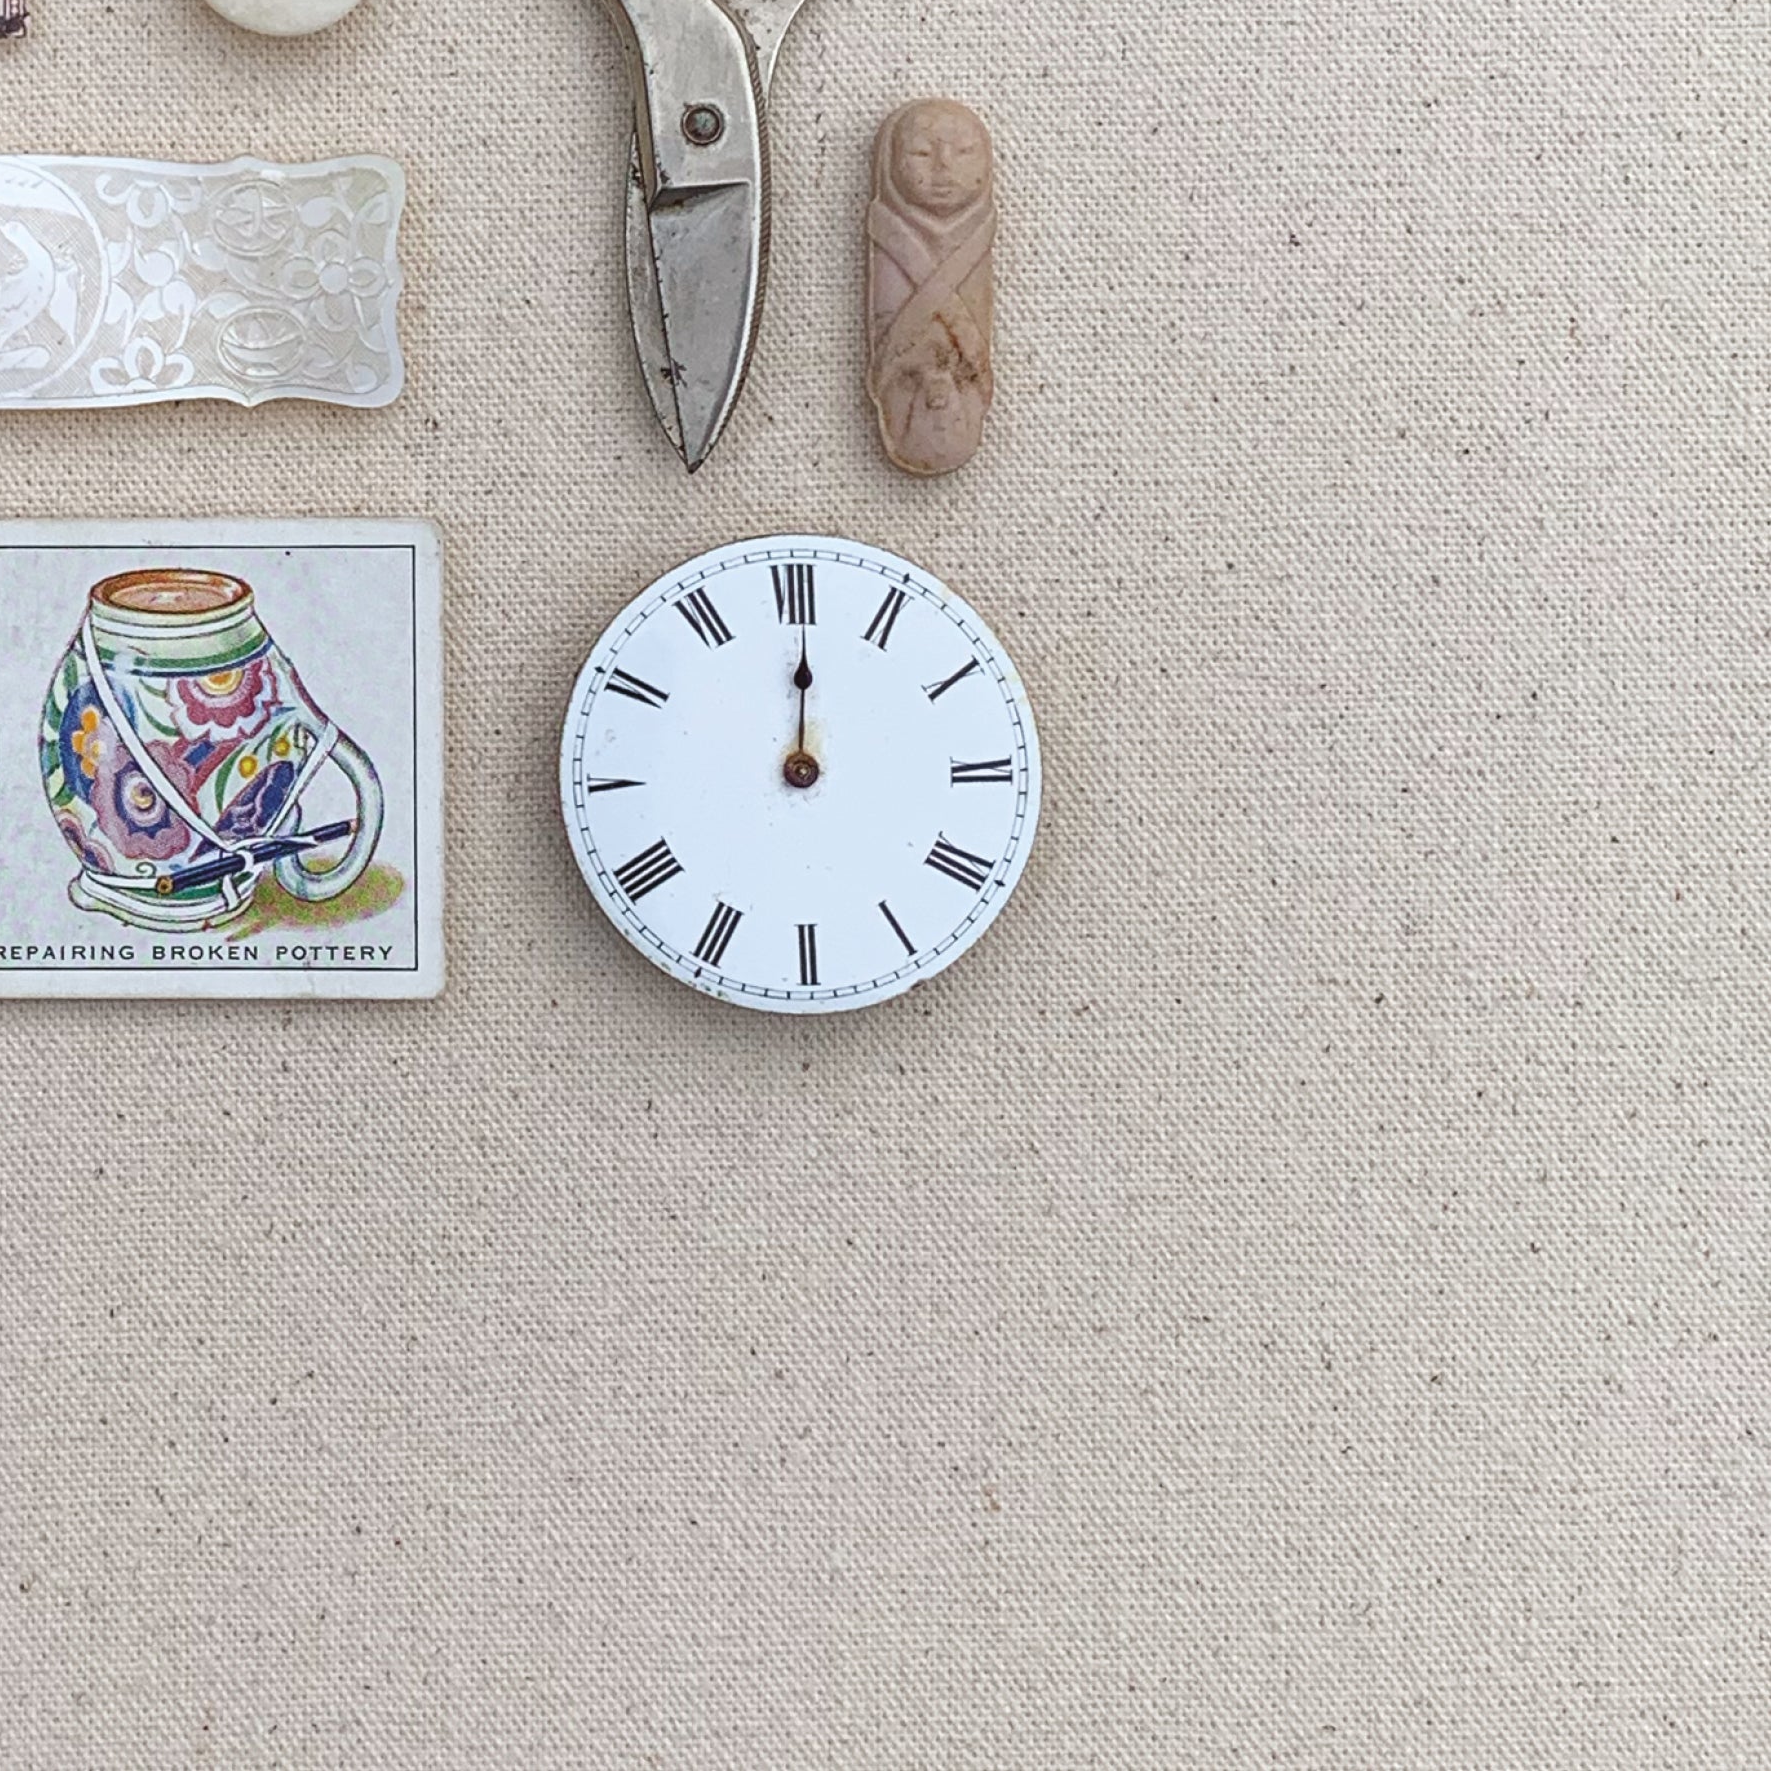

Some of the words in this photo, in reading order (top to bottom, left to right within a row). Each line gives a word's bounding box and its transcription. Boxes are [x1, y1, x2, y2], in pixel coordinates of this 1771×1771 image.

[770, 564, 816, 625] VIII
[922, 656, 985, 704] X
[588, 774, 646, 794] V
[152, 943, 259, 960] BROKEN
[276, 943, 392, 962] POTTERY
[795, 923, 820, 985] II
